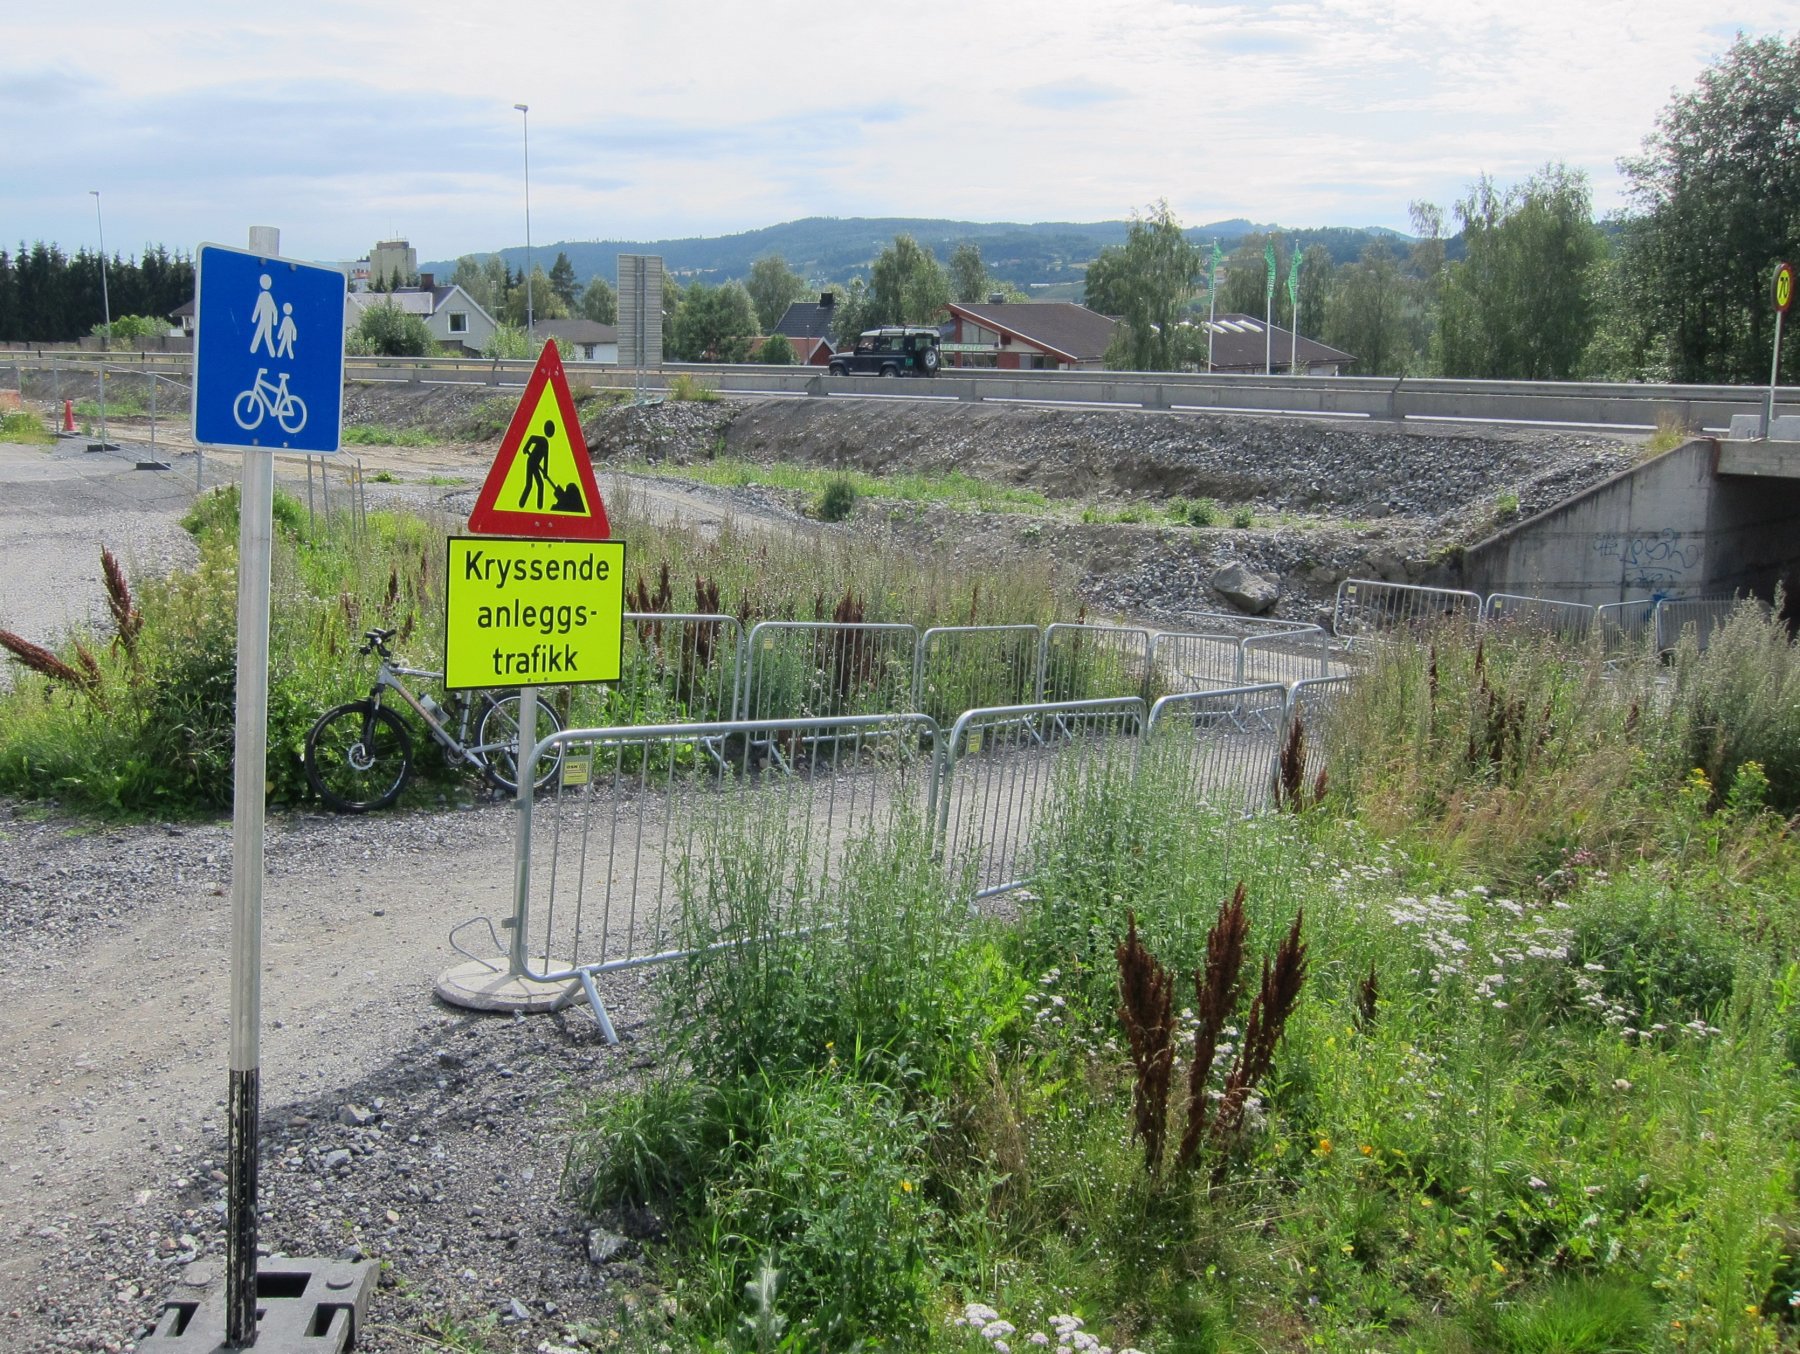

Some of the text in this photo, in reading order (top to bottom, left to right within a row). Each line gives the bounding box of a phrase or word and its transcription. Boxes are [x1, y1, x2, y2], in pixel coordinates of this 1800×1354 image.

[1780, 276, 1789, 298] 70
[465, 550, 609, 588] Kryssende
[478, 599, 597, 634] anleggs-
[493, 645, 578, 675] trafikk
